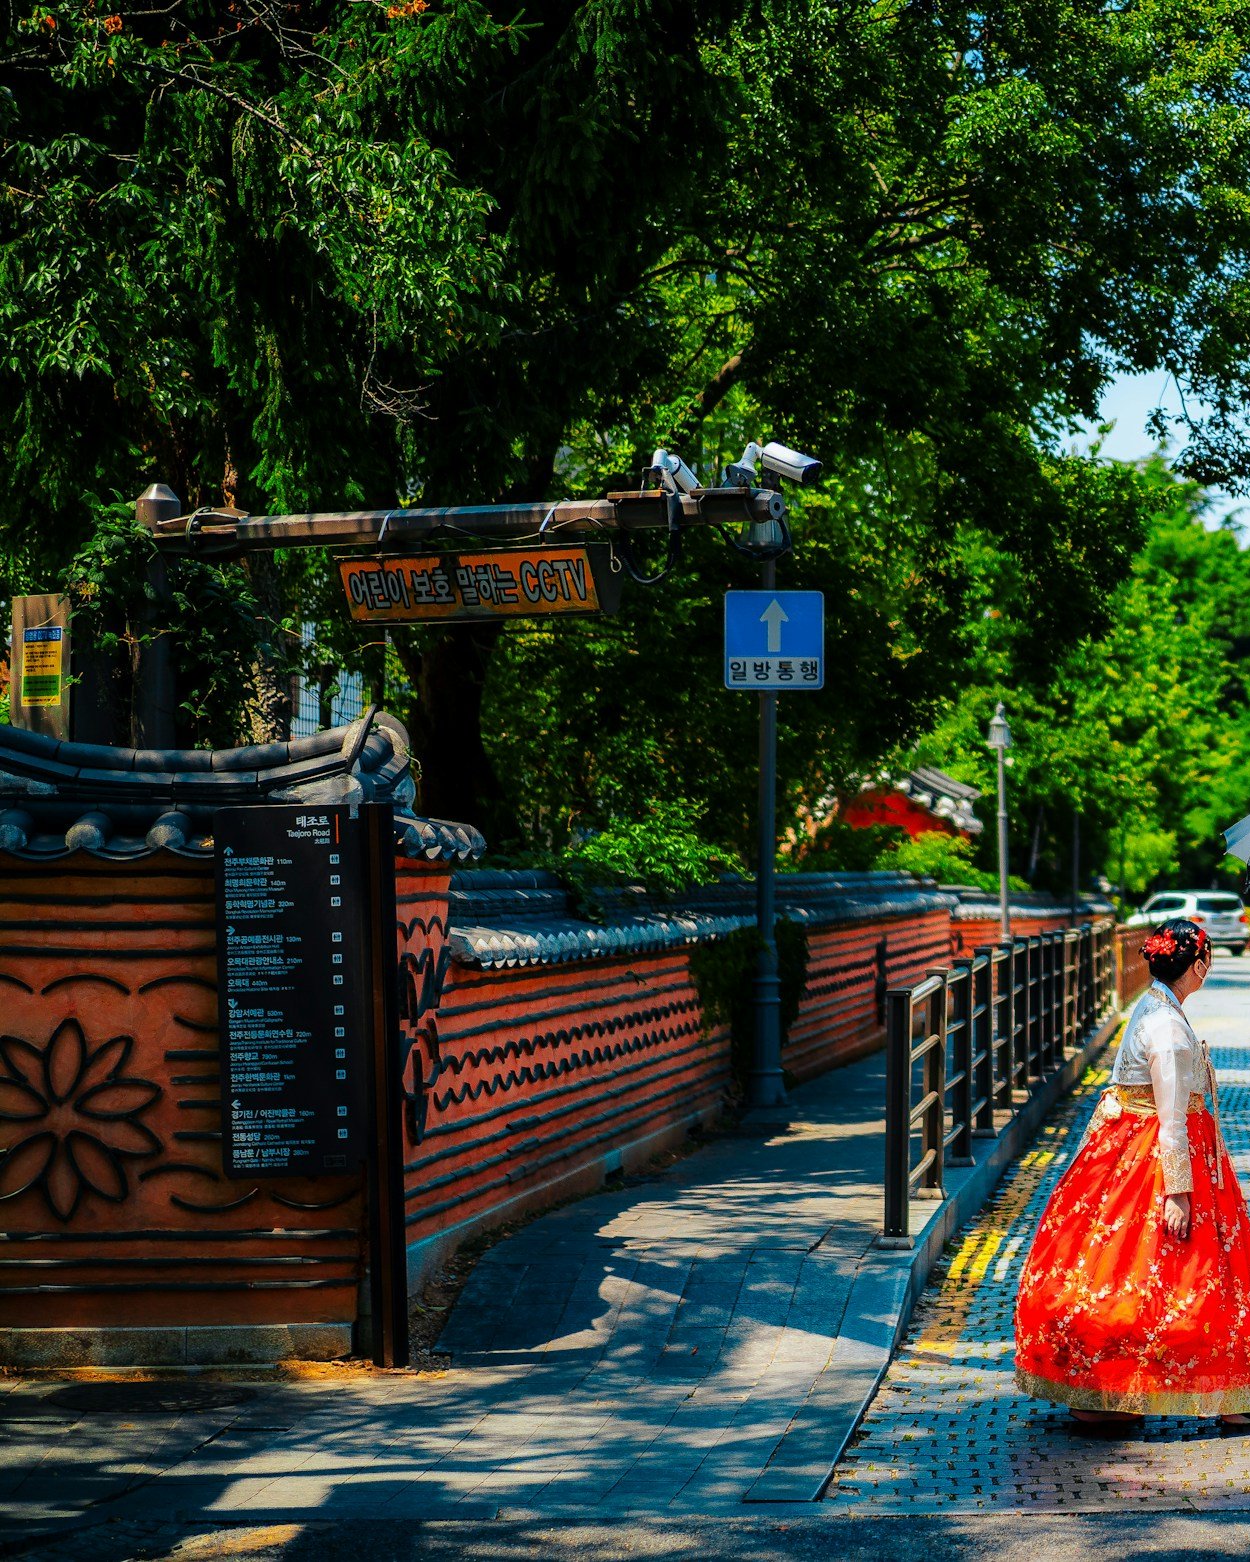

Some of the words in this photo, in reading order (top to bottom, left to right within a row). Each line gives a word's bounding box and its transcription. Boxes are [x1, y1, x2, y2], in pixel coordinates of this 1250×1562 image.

[348, 568, 410, 610] 어린이
[411, 567, 455, 605] 보호
[455, 564, 519, 607] 말하는
[520, 558, 588, 603] CCTV
[730, 661, 818, 681] 일방통행
[295, 815, 330, 828] 태조로
[286, 829, 312, 839] Taejoro
[312, 828, 331, 837] Road
[231, 1109, 253, 1120] 경기전
[254, 1110, 258, 1119] /
[232, 1132, 261, 1142] 전동성당
[255, 1148, 260, 1158] /
